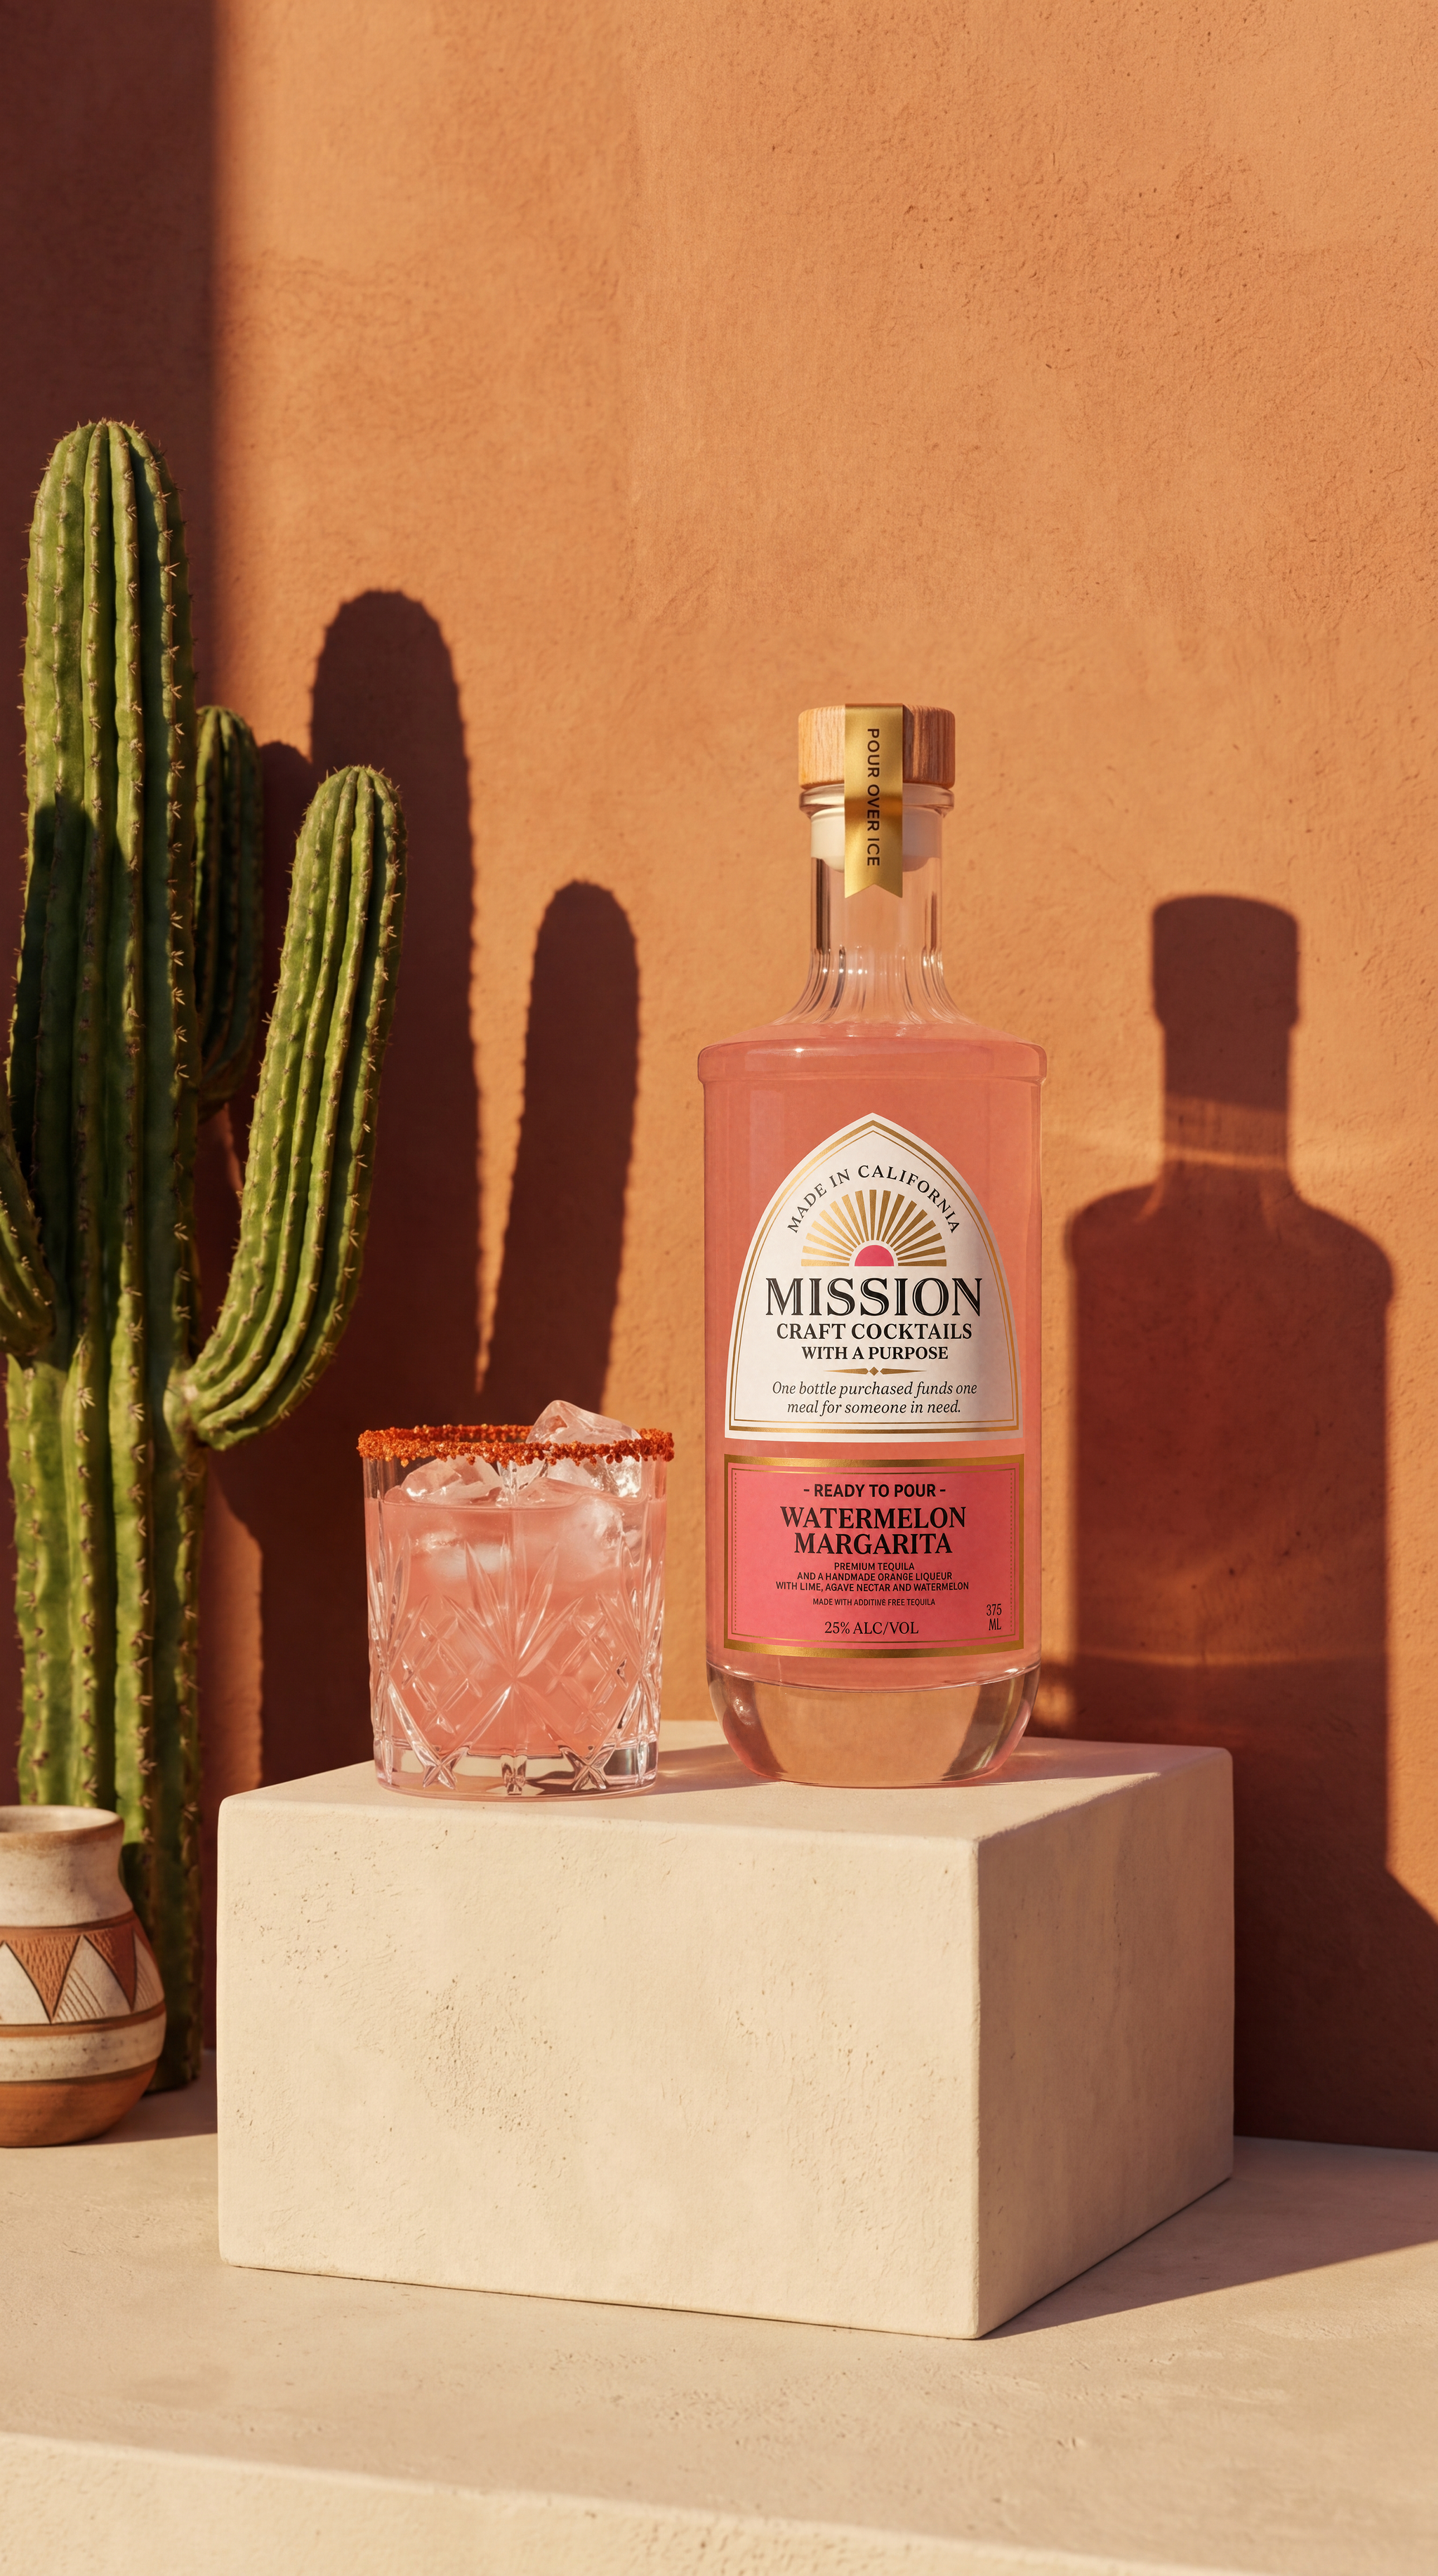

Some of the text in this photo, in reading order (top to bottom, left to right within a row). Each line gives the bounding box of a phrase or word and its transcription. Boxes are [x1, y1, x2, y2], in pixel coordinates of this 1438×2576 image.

[867, 729, 880, 866] POUR OVER ICE
[787, 1165, 960, 1234] MADE IN CALIFORNIA
[765, 1278, 982, 1317] MISSION
[777, 1323, 972, 1340] CRAFT COCKTAILS
[801, 1347, 949, 1360] WITH A PURPOSE
[772, 1381, 977, 1399] One bottle purchased funds one
[787, 1399, 961, 1417] meal for someone in need.
[814, 1484, 865, 1498] READY
[869, 1484, 890, 1498] TO
[894, 1484, 936, 1498] POUR
[780, 1506, 967, 1529] WATERMELON
[794, 1532, 954, 1555] MARGARITA
[834, 1562, 915, 1572] PREMIUM TEQUILA
[797, 1572, 816, 1580] AND
[825, 1573, 876, 1581] HANDMADE
[878, 1573, 913, 1581] ORANGE
[916, 1572, 953, 1582] LIQUEUR
[776, 1581, 969, 1592] WITH LIME, AGAVE NECTAR AND WATERMELON
[834, 1598, 852, 1606] WITH
[906, 1598, 936, 1607] TEQUILA
[986, 1604, 1002, 1616] 375
[824, 1621, 919, 1636] 25% ALC/VOL
[989, 1618, 1002, 1631] ML
